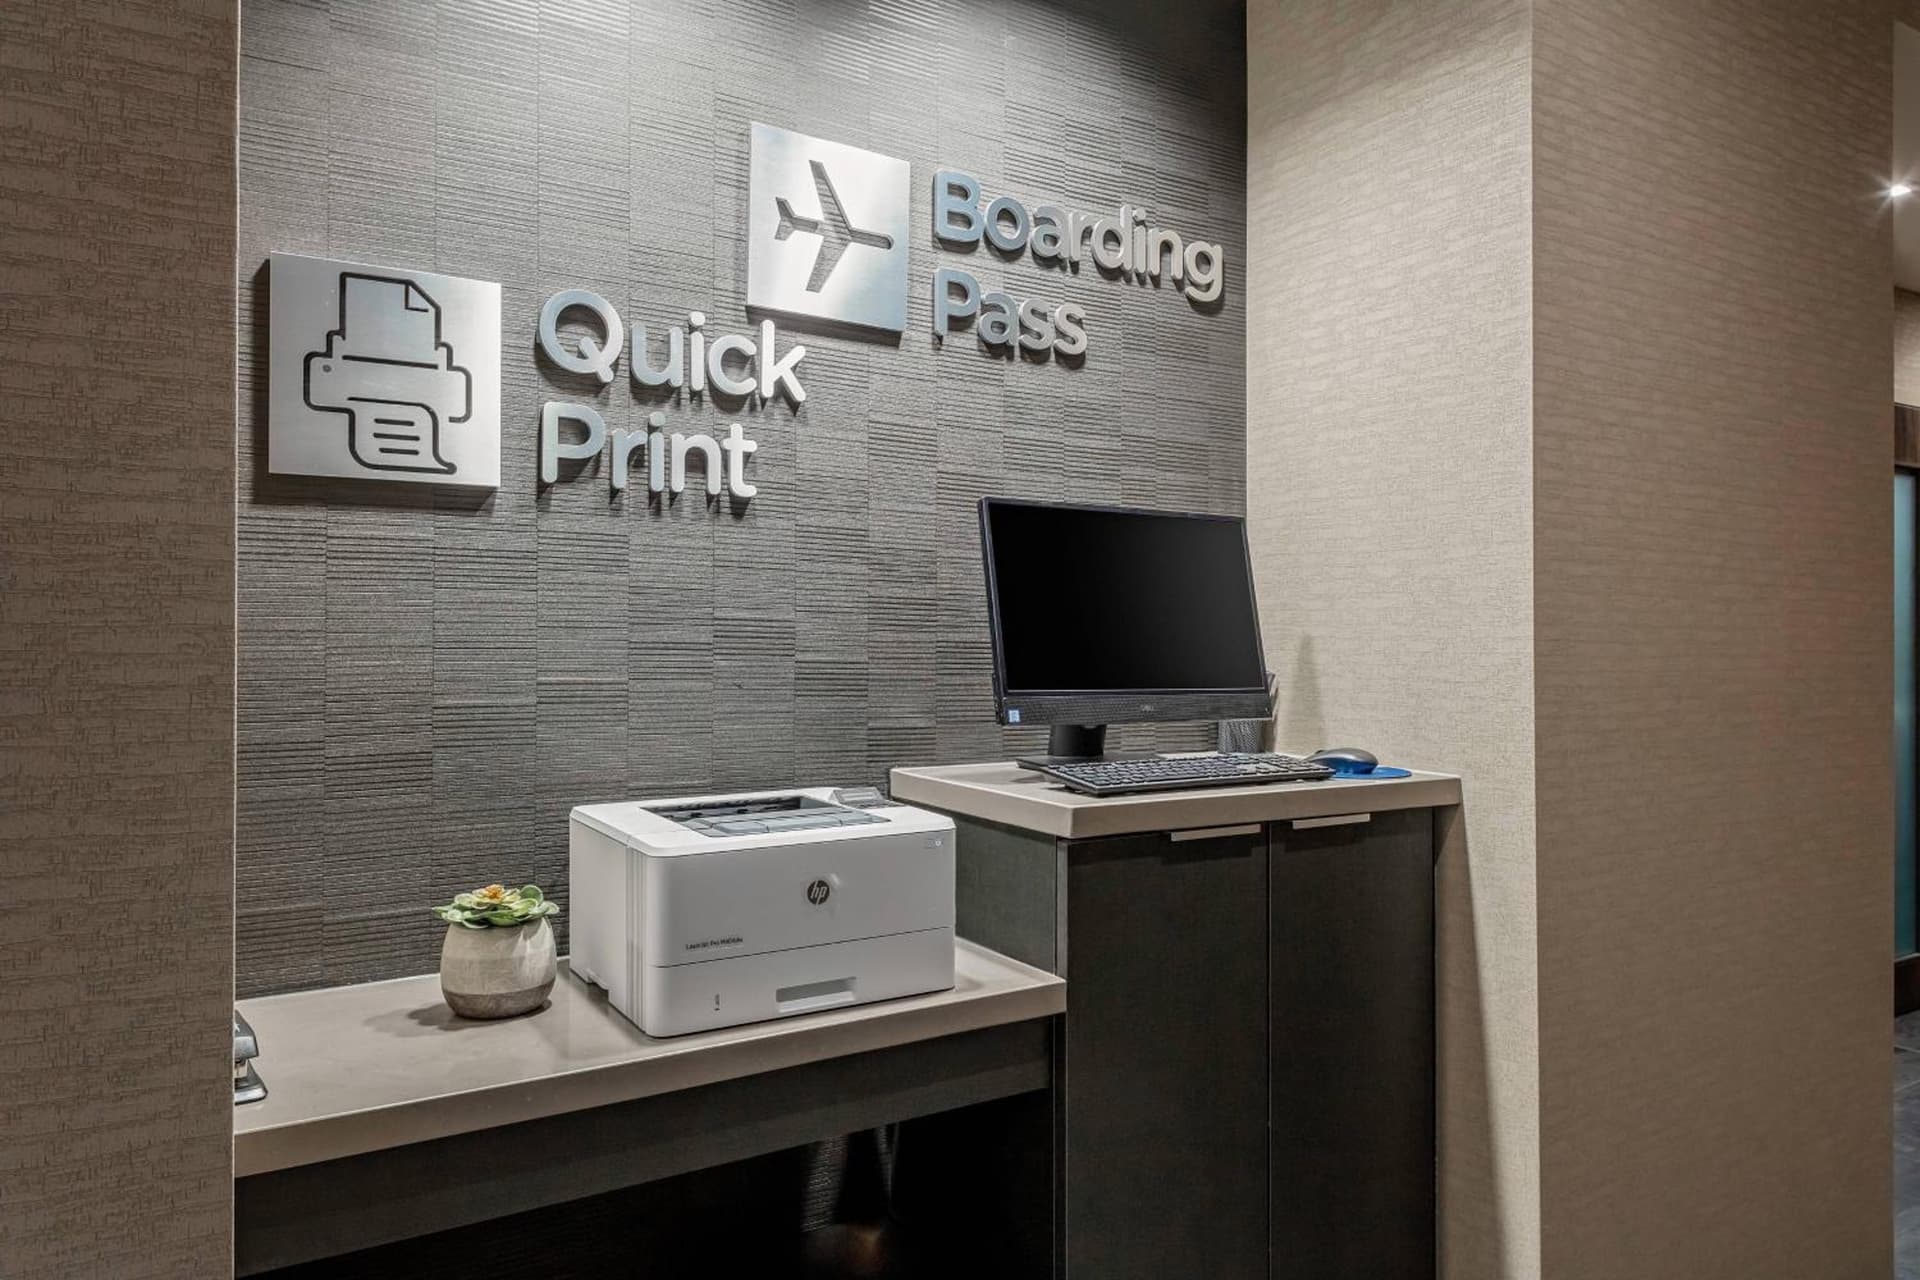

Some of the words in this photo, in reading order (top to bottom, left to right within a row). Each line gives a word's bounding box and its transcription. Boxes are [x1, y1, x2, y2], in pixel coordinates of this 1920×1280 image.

[934, 169, 1224, 301] Boarding
[537, 290, 806, 402] Quick
[934, 268, 1088, 356] Pass
[540, 402, 757, 498] Print
[808, 880, 829, 905] hp
